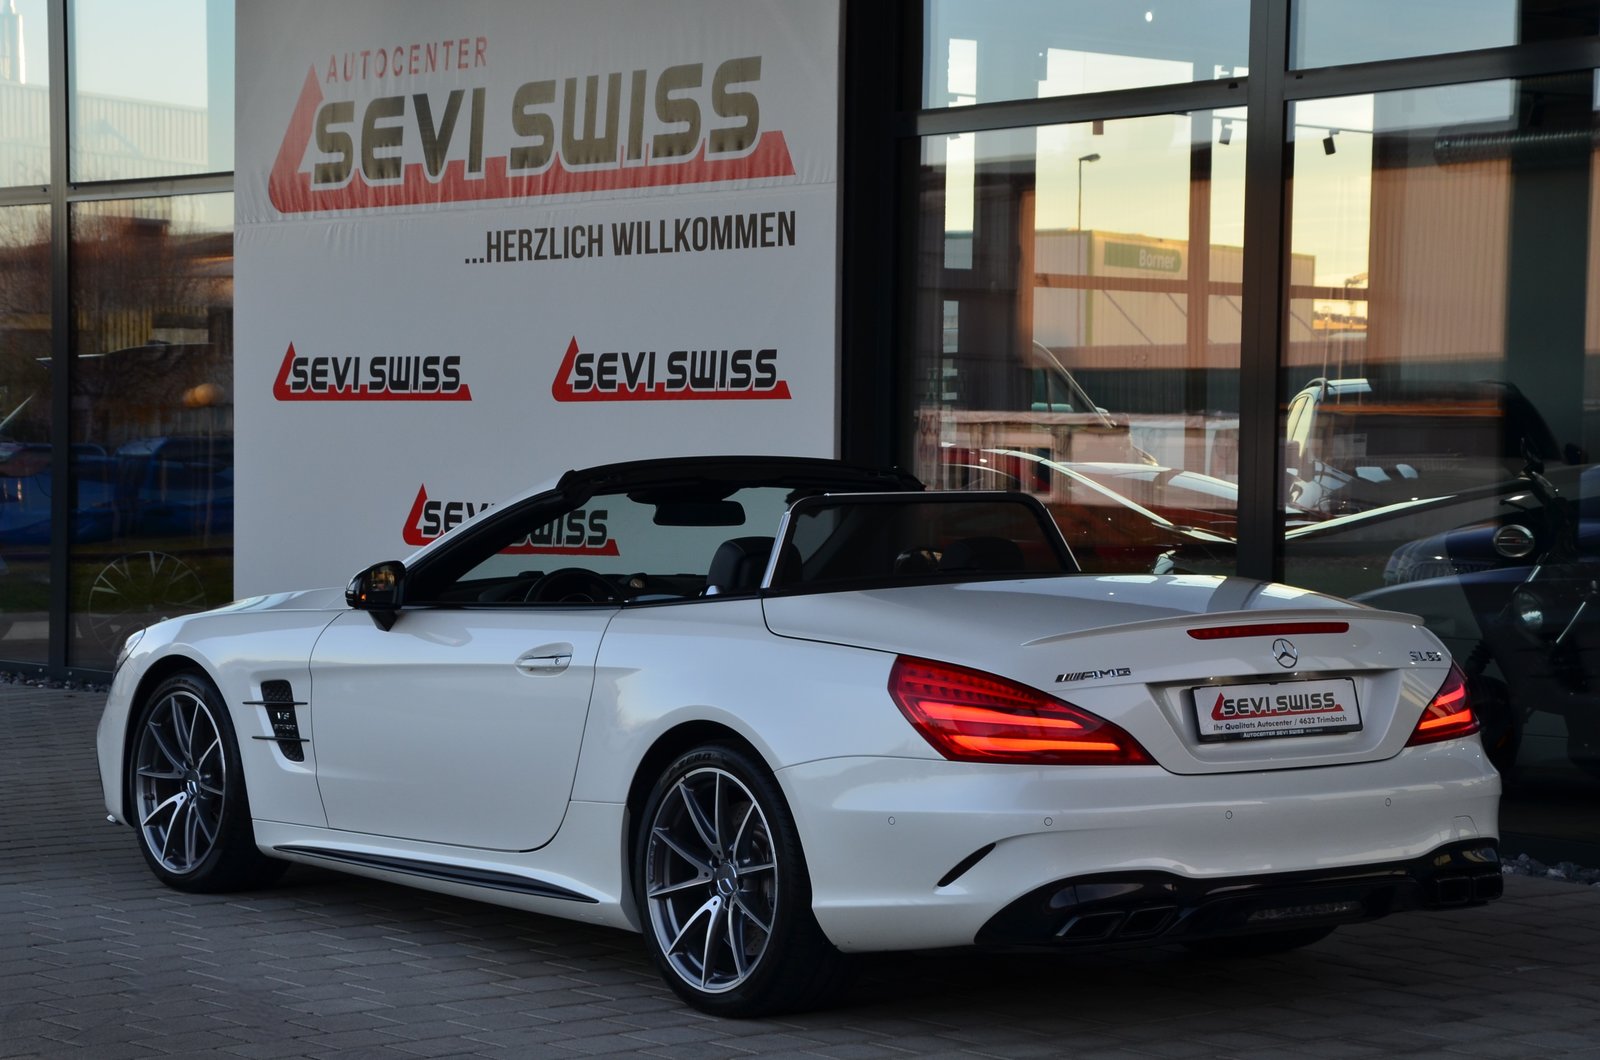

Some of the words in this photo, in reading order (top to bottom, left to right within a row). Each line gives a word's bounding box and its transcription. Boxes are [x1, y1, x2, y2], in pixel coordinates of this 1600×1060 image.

[326, 36, 488, 83] AUTOCENTER
[313, 87, 486, 185] SEVI
[510, 55, 762, 170] SWISS
[465, 223, 603, 264] ...HERZLICH
[612, 210, 796, 256] WILLKOMMEN
[291, 356, 360, 391] SEVI
[369, 355, 460, 391] SWISS
[573, 352, 656, 391] SEVI
[666, 349, 778, 391] SWISS
[424, 501, 494, 535] SEV
[515, 510, 608, 546] WISS
[1223, 696, 1270, 715] SEVI
[1276, 692, 1335, 711] SWISS
[1257, 719, 1293, 728] Autocenter
[1299, 717, 1315, 725] 4632
[1317, 714, 1347, 724] Trimbach
